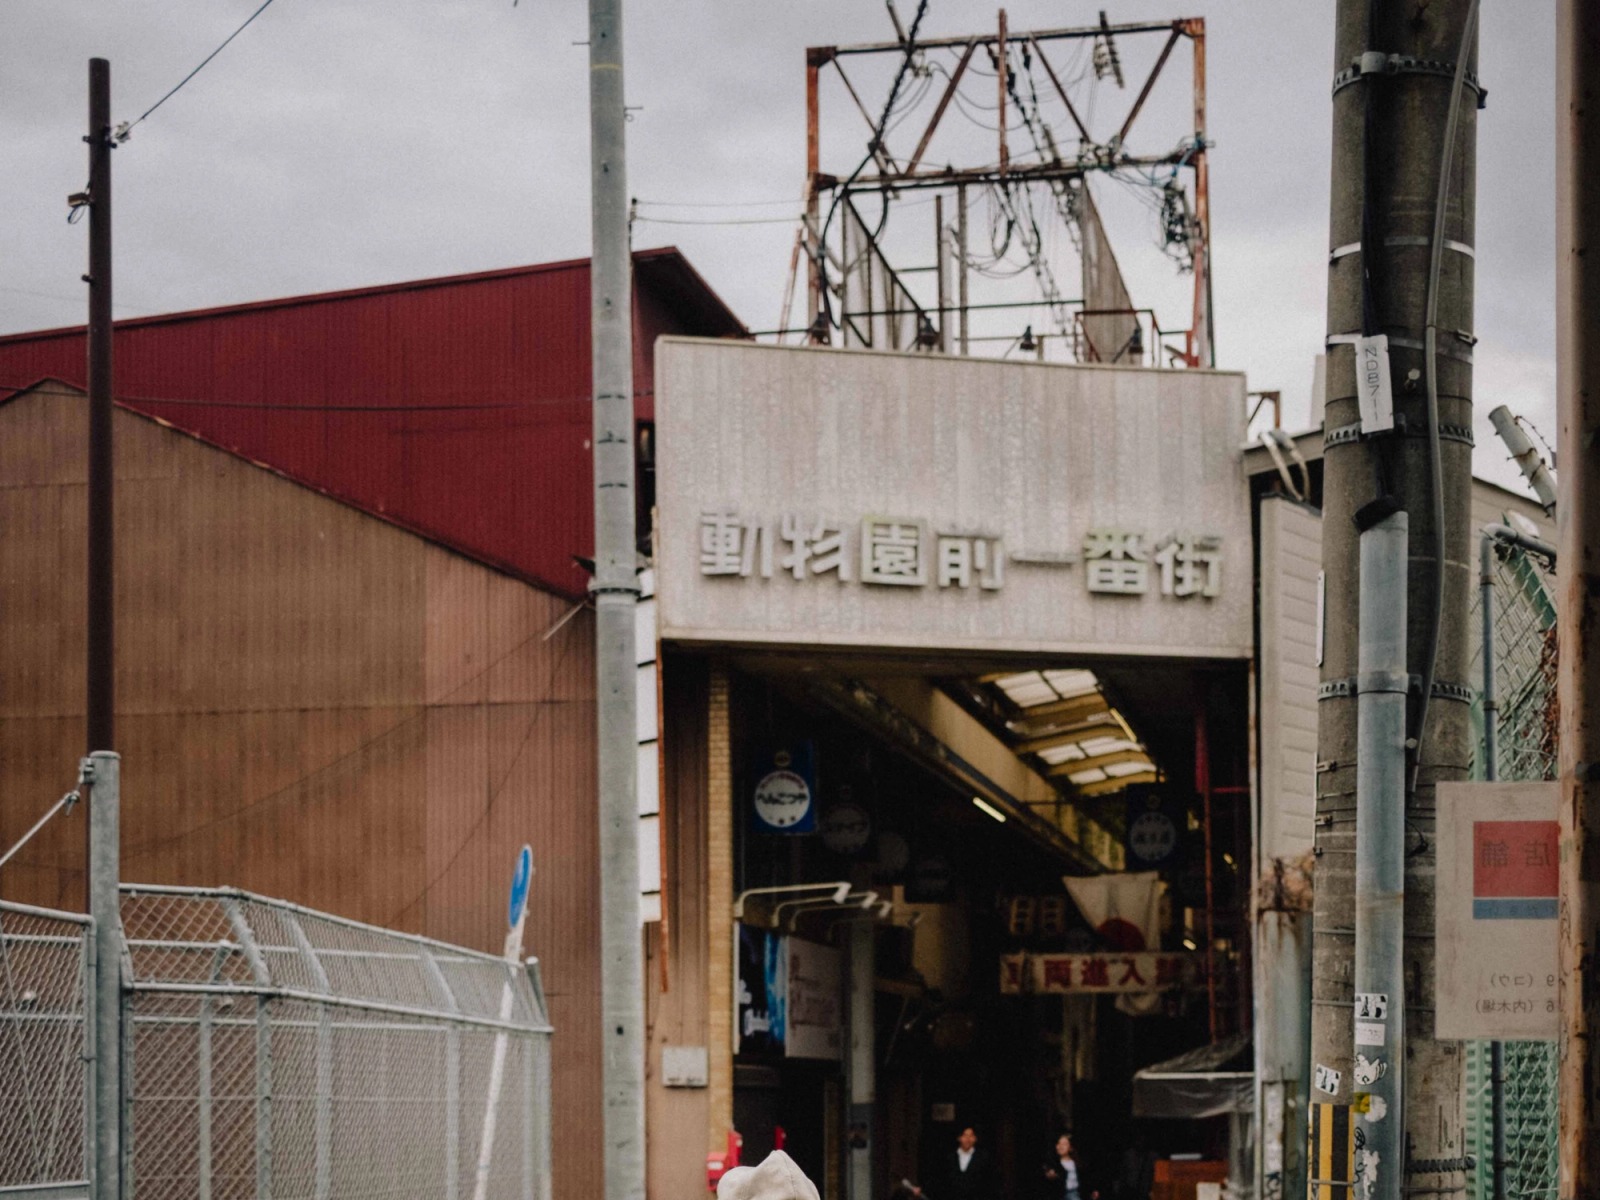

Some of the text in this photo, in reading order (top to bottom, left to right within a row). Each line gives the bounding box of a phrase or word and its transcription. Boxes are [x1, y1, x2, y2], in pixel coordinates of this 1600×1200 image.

[700, 511, 1222, 599] 動物園前一番街
